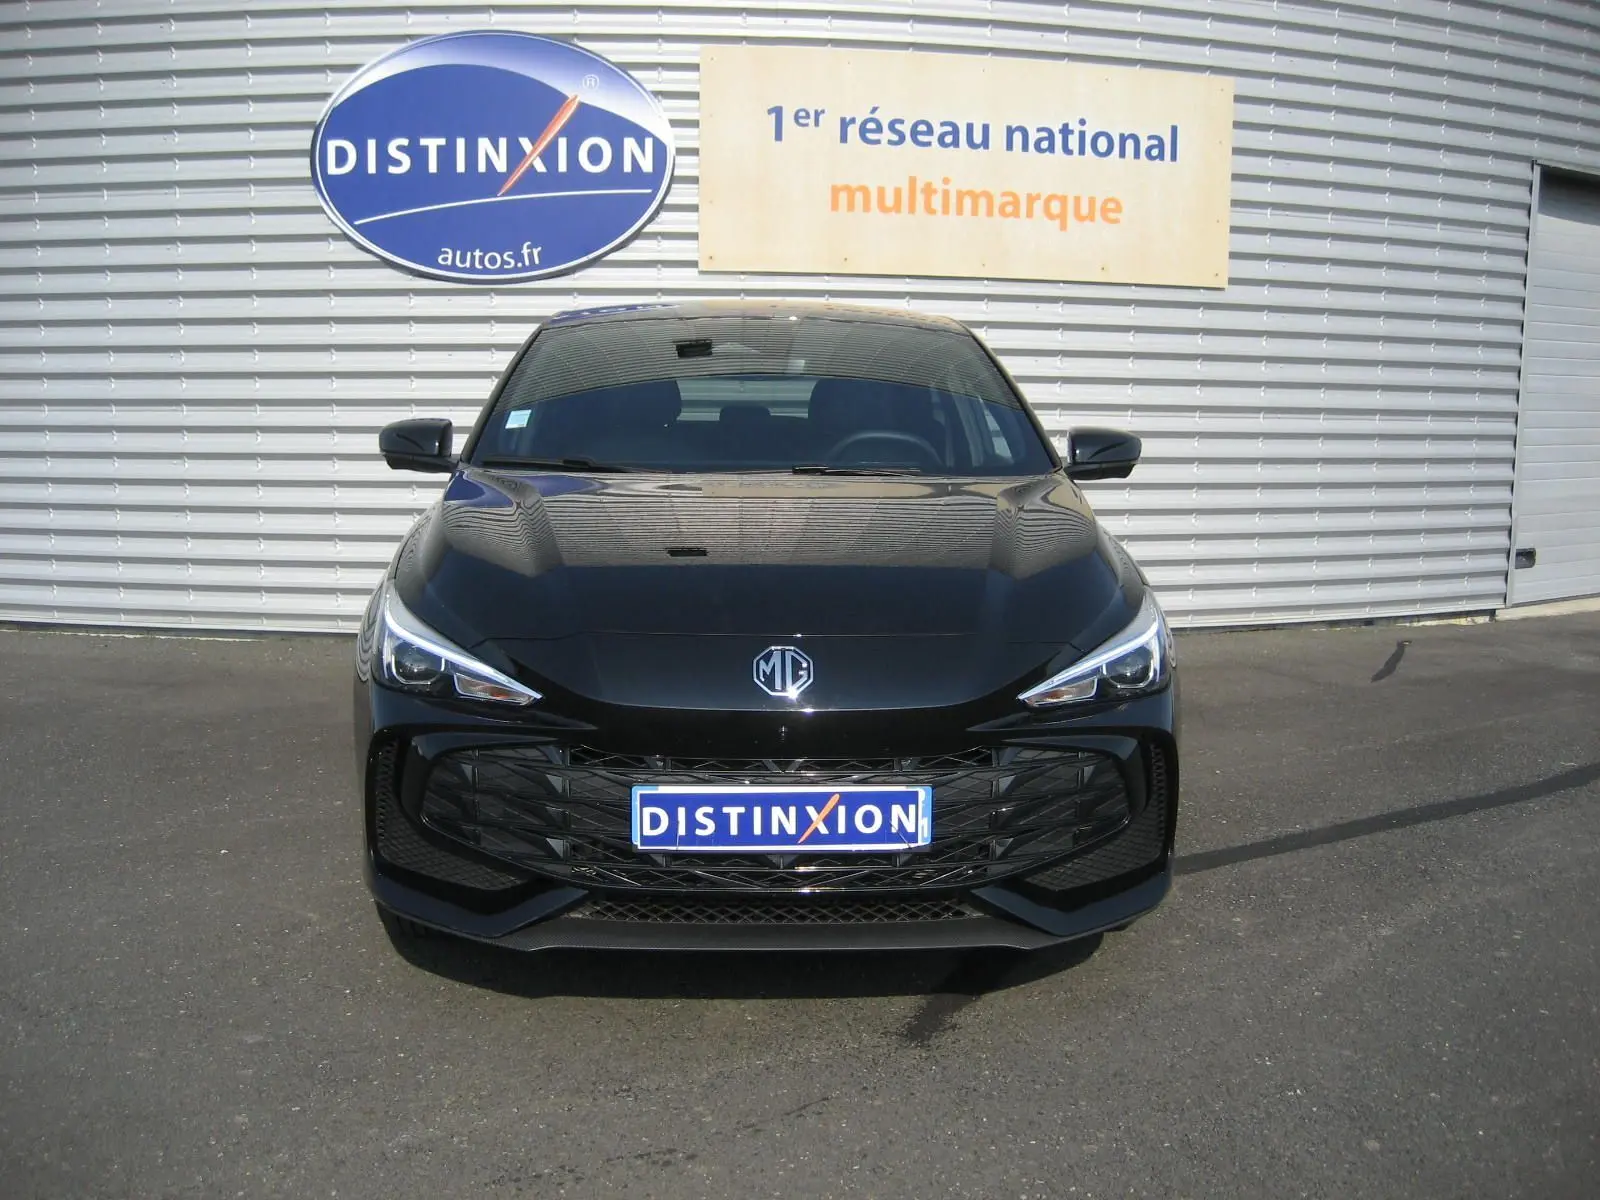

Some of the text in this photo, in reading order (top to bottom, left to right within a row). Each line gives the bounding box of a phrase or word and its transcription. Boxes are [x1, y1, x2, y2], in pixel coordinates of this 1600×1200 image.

[766, 105, 1179, 162] 1er réseau national
[326, 136, 655, 176] DISTINXION
[829, 176, 1124, 231] multimarque
[437, 241, 542, 270] autos.fr
[758, 650, 810, 691] MG
[642, 803, 916, 837] DISTINXION
